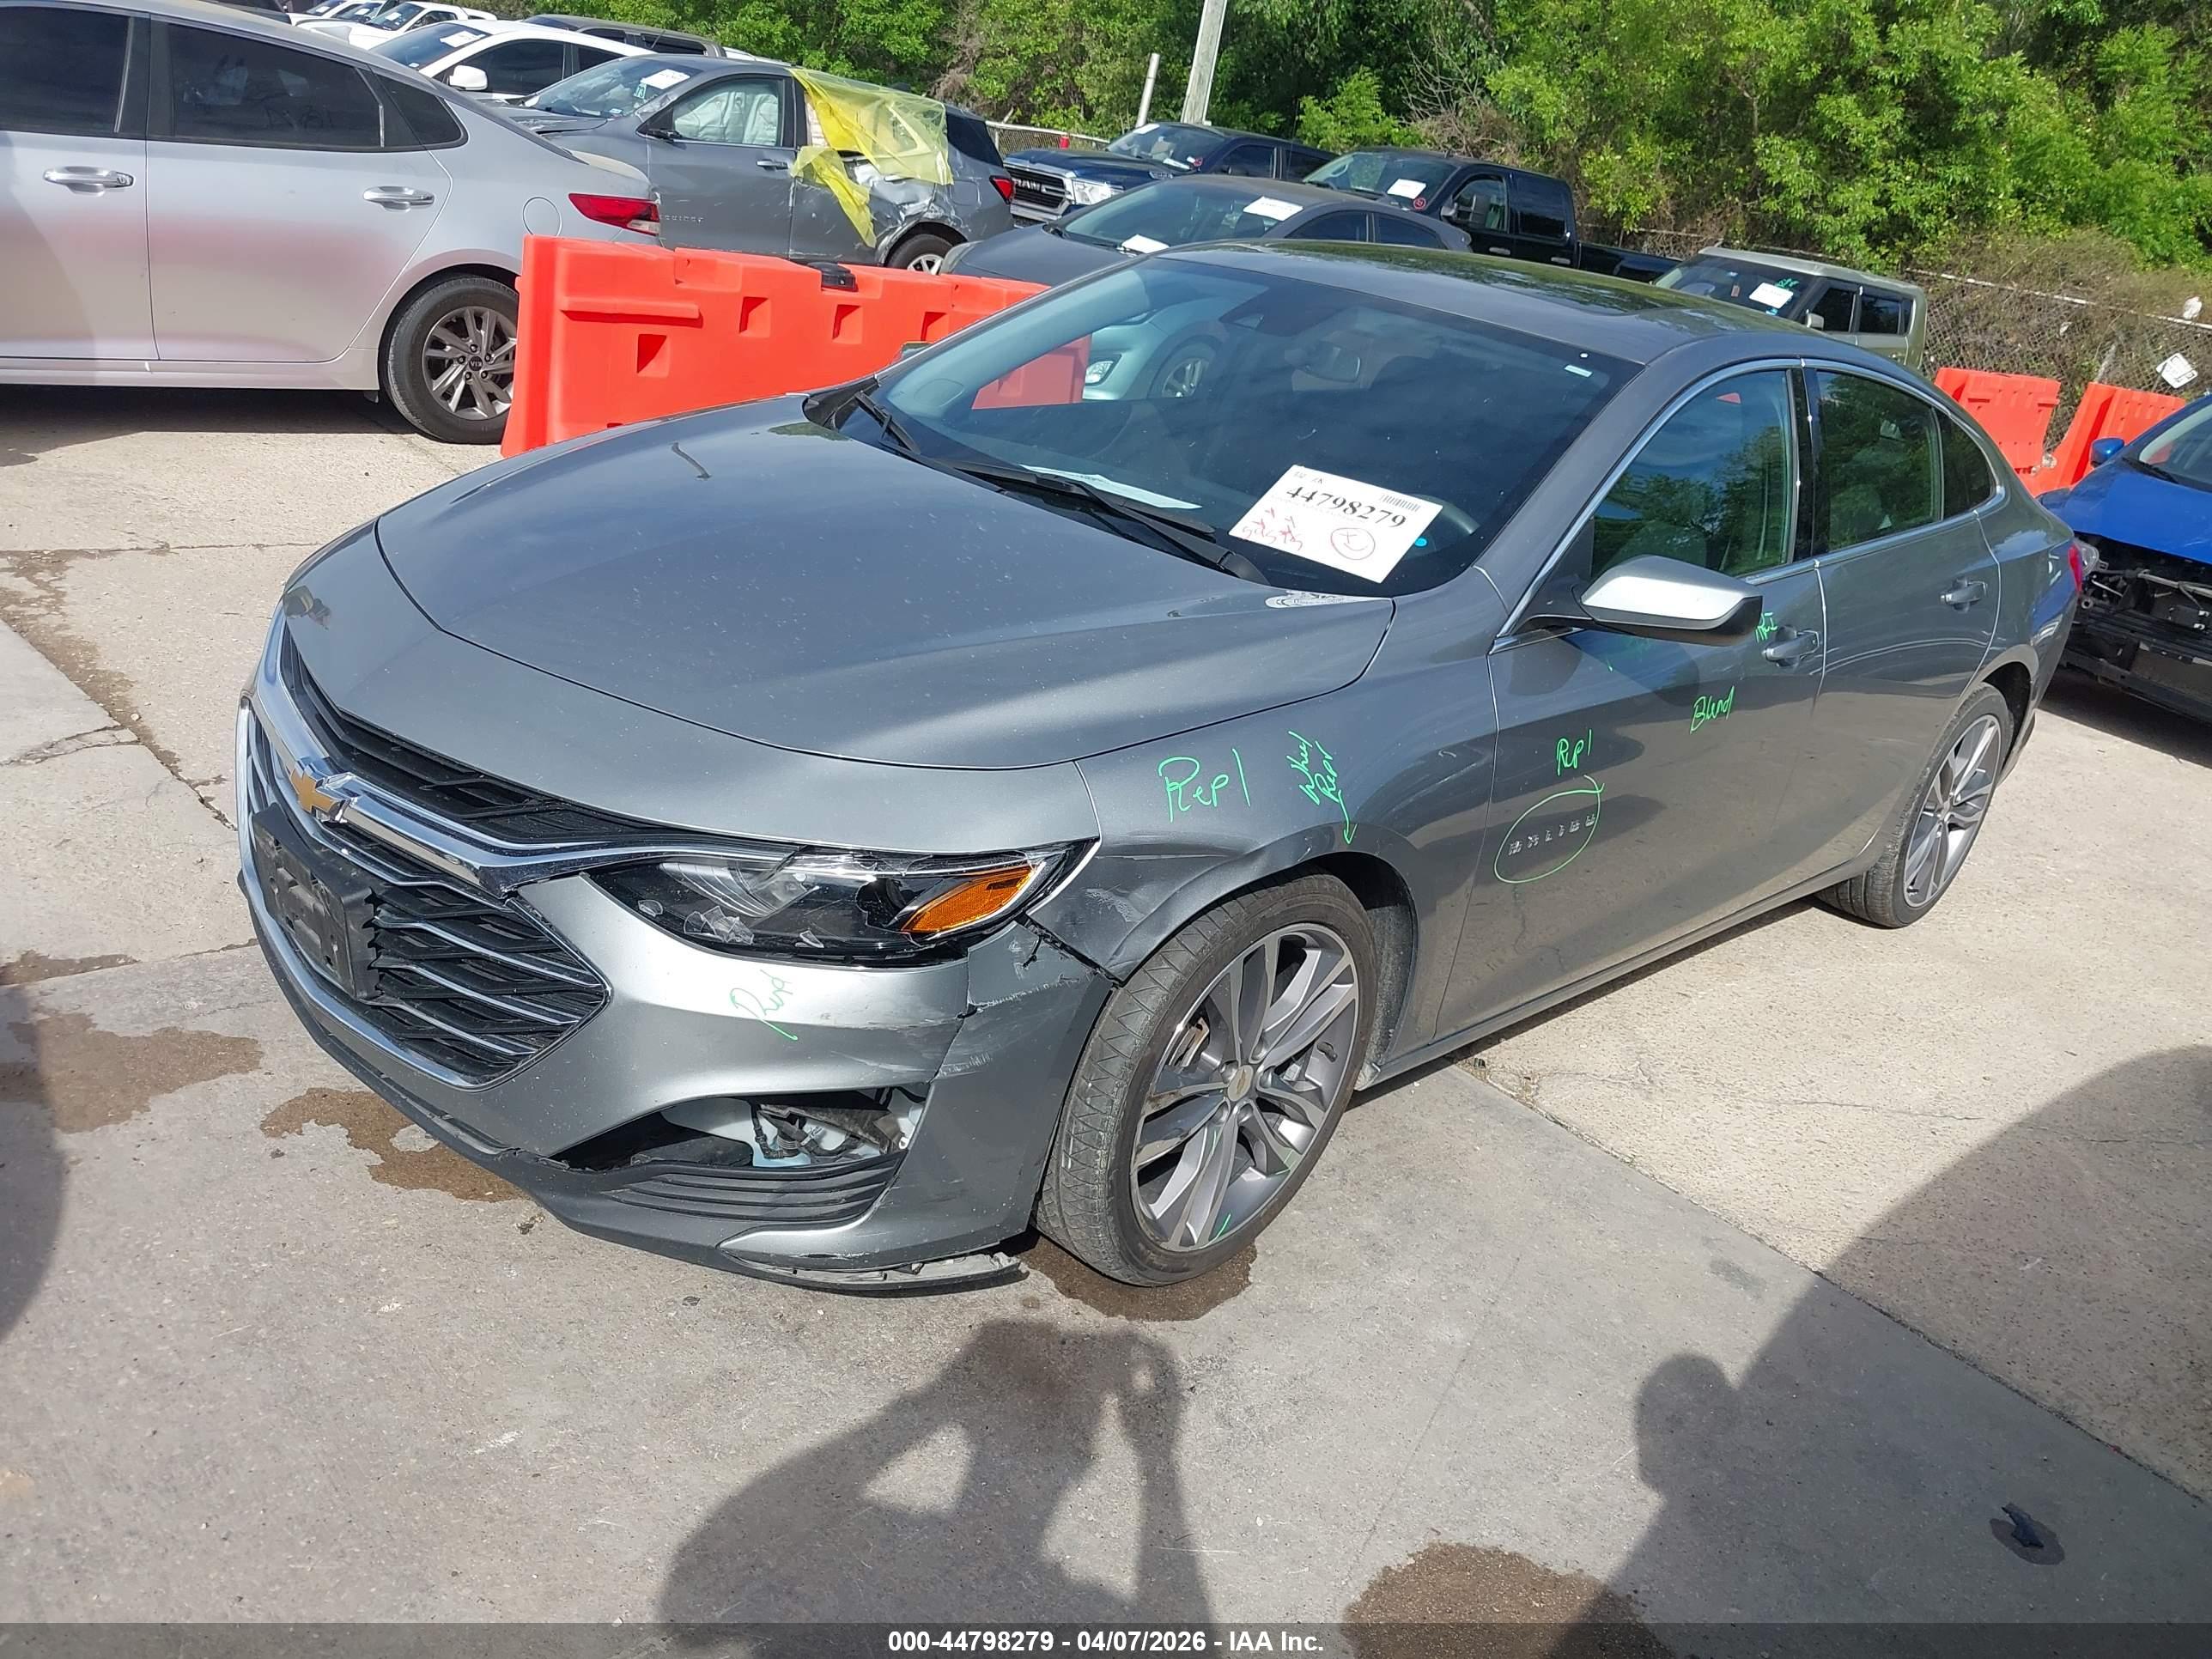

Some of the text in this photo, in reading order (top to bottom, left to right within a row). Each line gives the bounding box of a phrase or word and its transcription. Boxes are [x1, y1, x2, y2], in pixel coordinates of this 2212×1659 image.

[1012, 177, 1041, 191] RAM
[1286, 487, 1407, 527] 44798279
[1689, 685, 1735, 735] Blend
[1508, 814, 1596, 856] MALIBU
